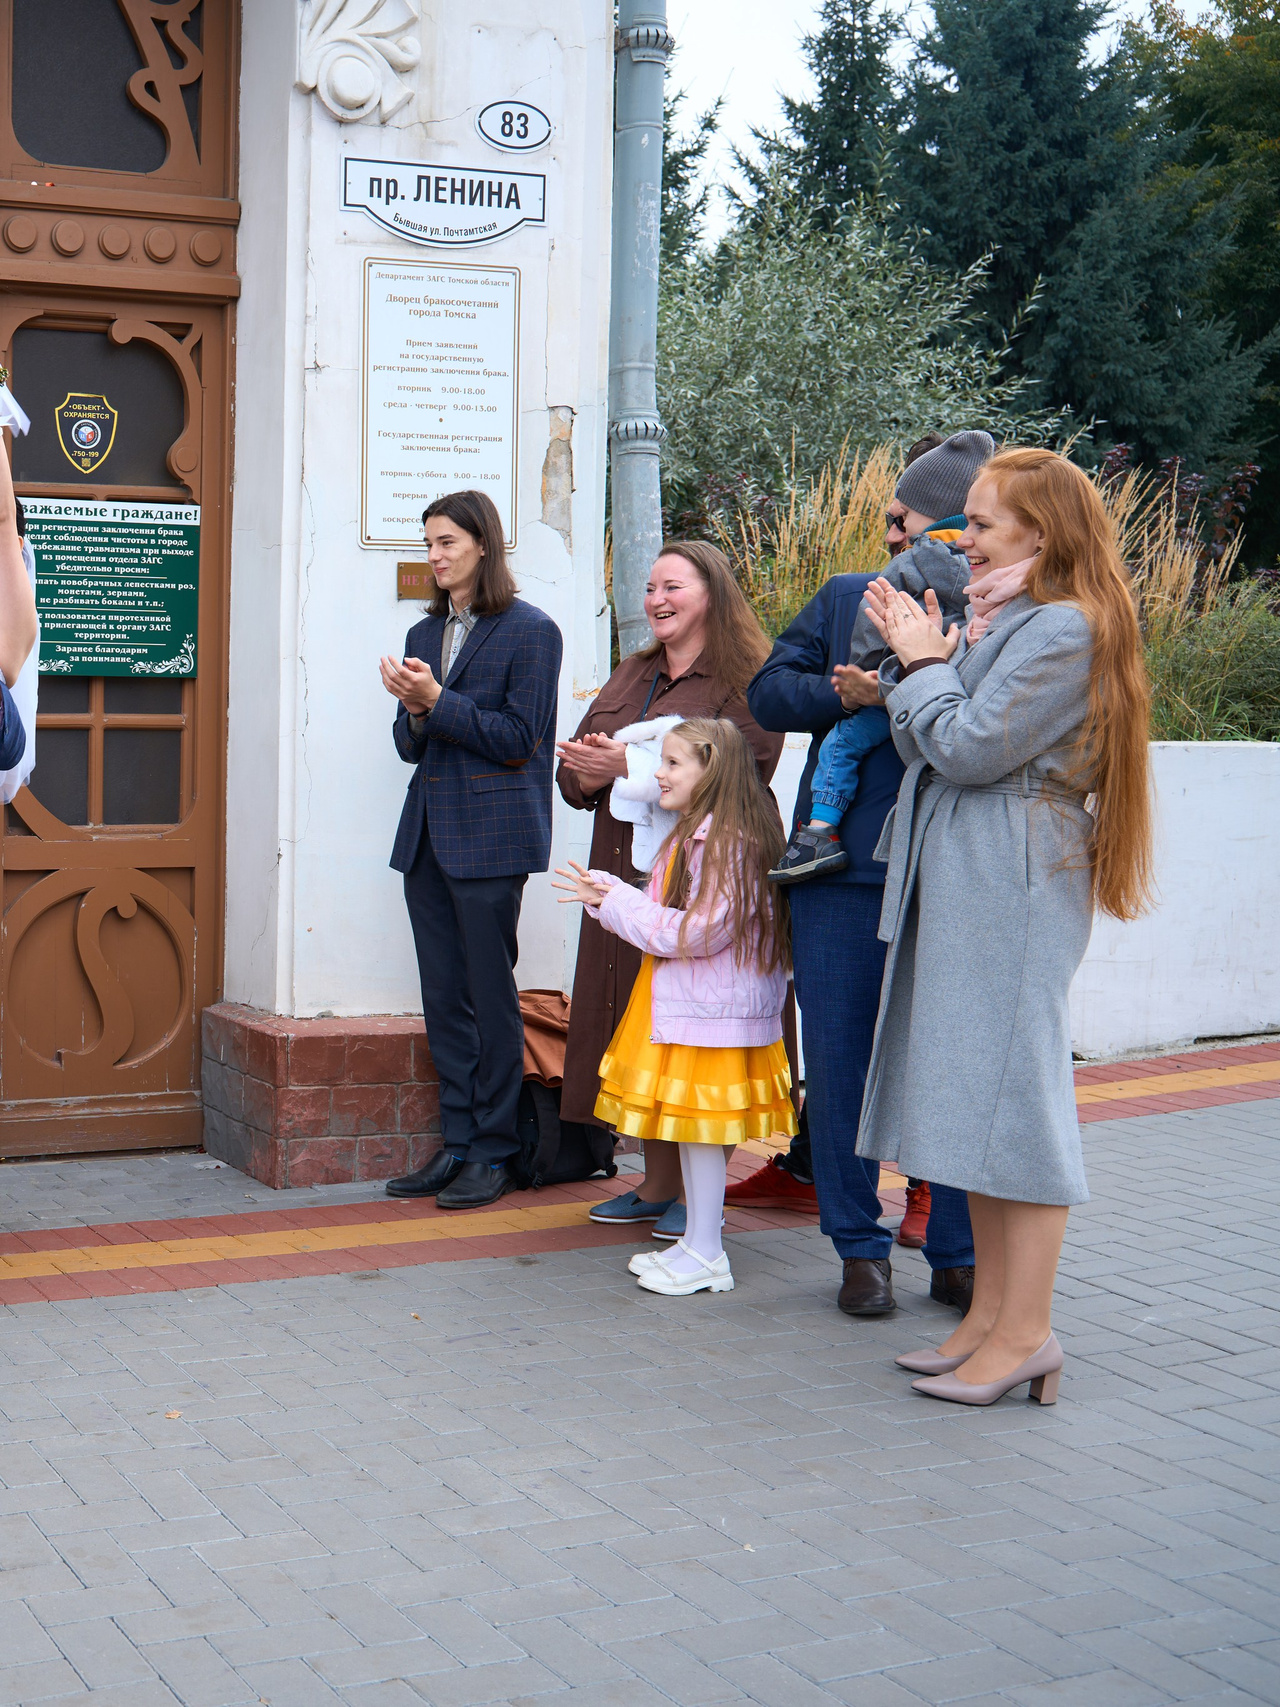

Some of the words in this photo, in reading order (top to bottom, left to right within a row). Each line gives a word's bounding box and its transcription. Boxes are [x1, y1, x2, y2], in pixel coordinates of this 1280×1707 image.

[501, 111, 529, 139] 83
[369, 177, 405, 206] пр.
[413, 175, 521, 210] ЛЕНИНА
[392, 212, 428, 233] Бывшая
[429, 226, 442, 236] ул.
[443, 221, 498, 237] Почтамтская
[375, 272, 424, 281] Департамент
[427, 275, 446, 283] ЗАГС
[448, 276, 479, 285] Томской
[480, 278, 510, 287] области
[385, 293, 421, 305] Дворец
[423, 295, 499, 309] бракосочетаний
[408, 308, 441, 318] города
[444, 309, 477, 319] Томска
[406, 339, 433, 348] Прием
[435, 342, 478, 350] заявлений
[412, 353, 484, 364] государственную
[373, 364, 428, 374] регистрацию
[430, 367, 480, 375] заключения
[482, 369, 509, 378] брака.
[397, 385, 432, 393] вторник
[383, 401, 407, 409] среда
[415, 403, 448, 411] четверг
[63, 411, 110, 419] ОХРАНЯЕТСЯ
[377, 430, 449, 440] Государственная
[451, 433, 503, 443] регистрация
[401, 444, 451, 452] заключения
[453, 445, 480, 454] брака:
[392, 491, 428, 499] перерыв
[22, 504, 108, 517] важаемые
[113, 508, 198, 521] граждане!
[383, 516, 423, 524] воскресе
[42, 523, 99, 533] регистрации
[101, 526, 155, 535] заключения
[157, 526, 183, 537] брака
[53, 533, 109, 543] соблюдения
[111, 537, 148, 545] чистоты
[158, 538, 188, 547] городе
[84, 546, 140, 554] травматизма
[143, 548, 159, 556] при
[55, 554, 106, 563] помещения
[108, 556, 138, 565] отдела
[140, 556, 163, 565] ЗАГС
[56, 563, 112, 572] убедительно
[115, 566, 150, 575] просим:
[61, 578, 122, 588] новобрачных
[124, 581, 176, 589] лепестками
[178, 583, 196, 591] роз,
[58, 588, 104, 596] монетами,
[53, 596, 99, 605] разбивать
[101, 597, 135, 606] бокалы
[45, 612, 106, 620] пользоваться
[44, 622, 107, 630] прилегающей
[116, 624, 147, 632] органу
[74, 632, 130, 640] территории.
[56, 644, 93, 653] Заранее
[95, 645, 148, 655] благодарим
[82, 655, 134, 663] понимание.
